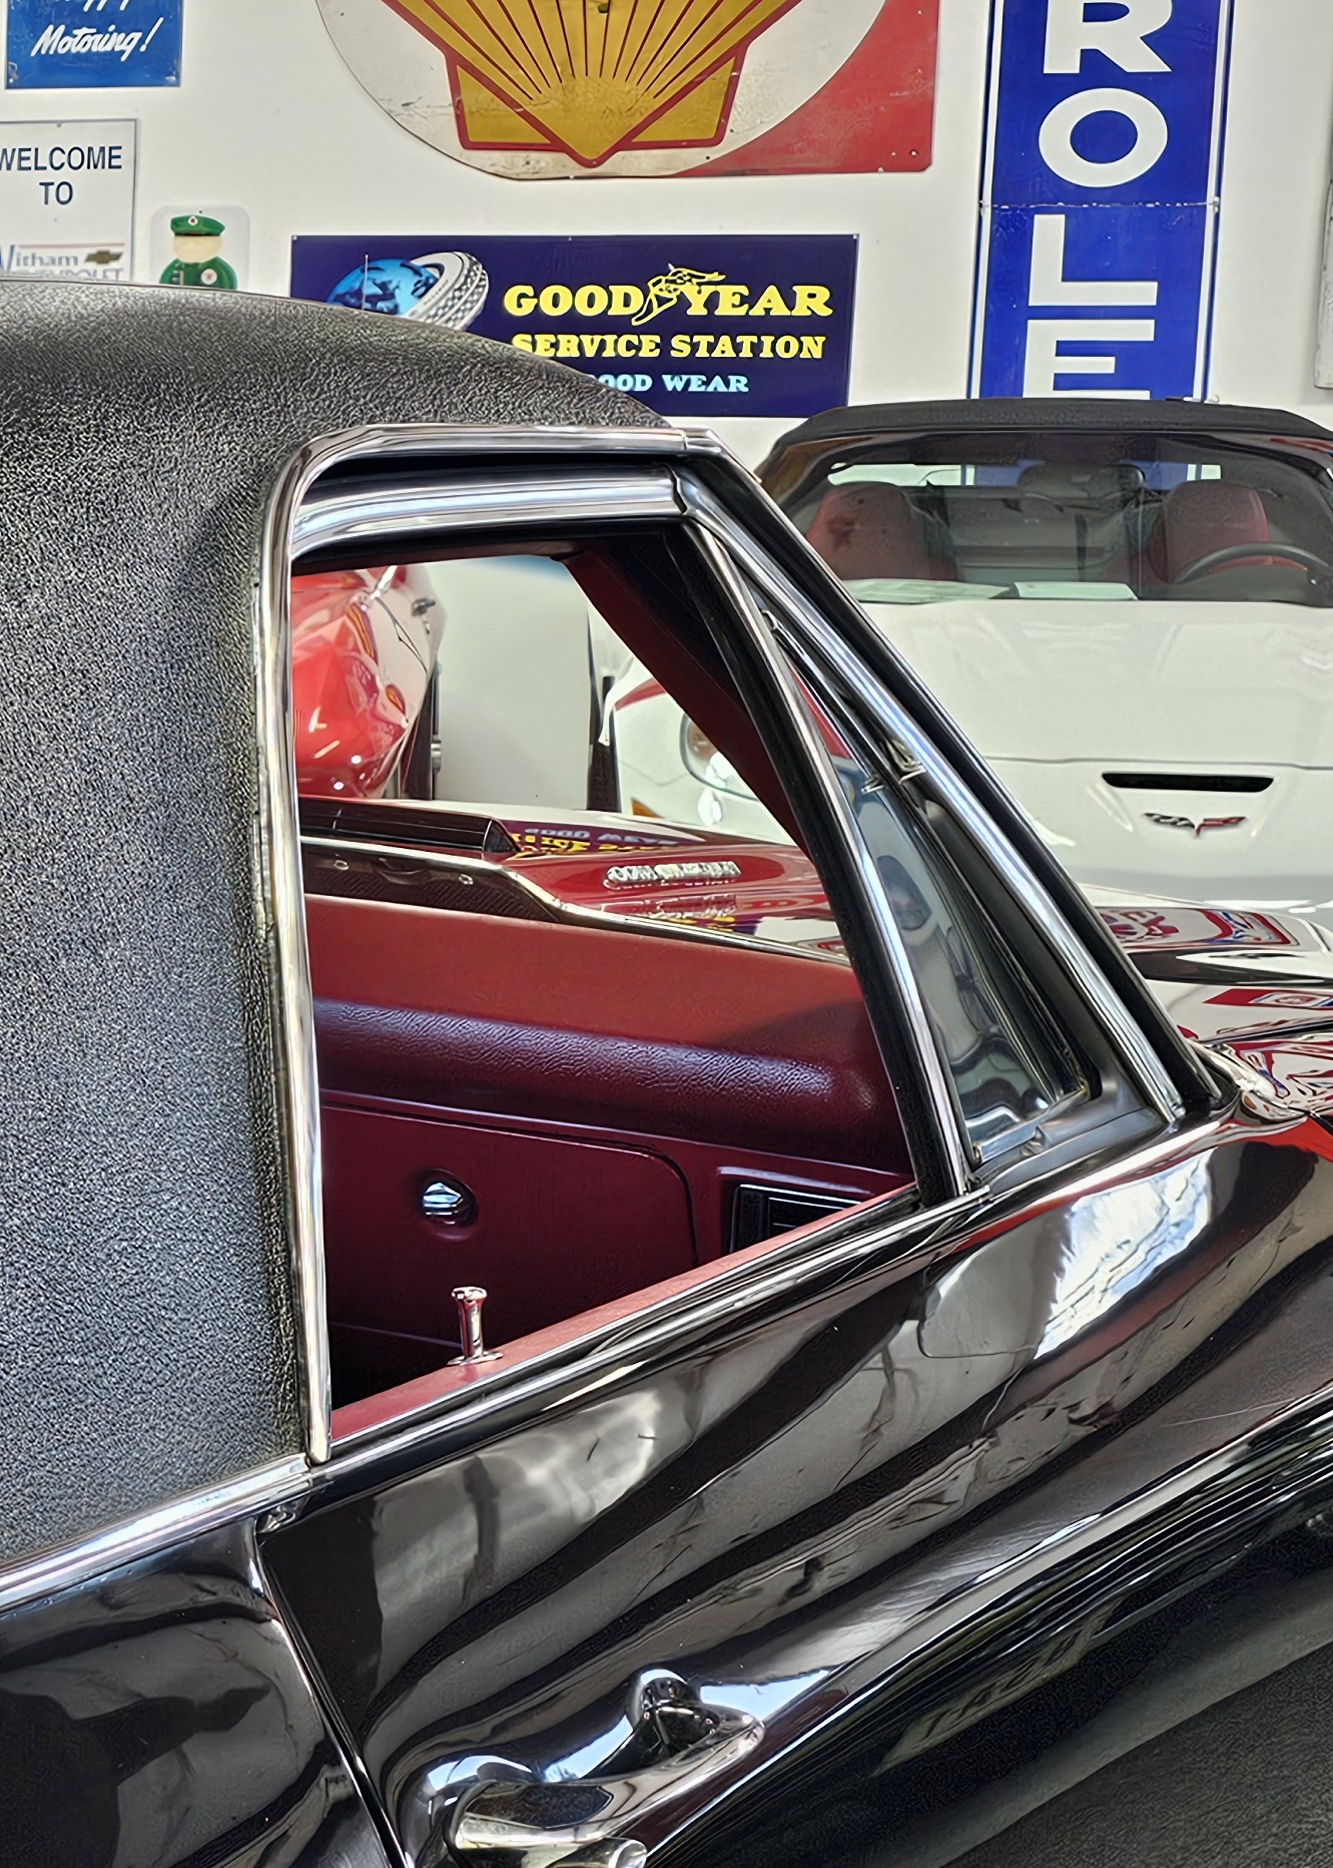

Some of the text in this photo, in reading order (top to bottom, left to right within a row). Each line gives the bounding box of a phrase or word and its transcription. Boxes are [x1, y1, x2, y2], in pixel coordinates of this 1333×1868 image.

[30, 17, 164, 62] Motoring!
[39, 181, 74, 205] TO
[512, 333, 827, 359] SERVICE STATION
[588, 374, 750, 393] OOD WEAR
